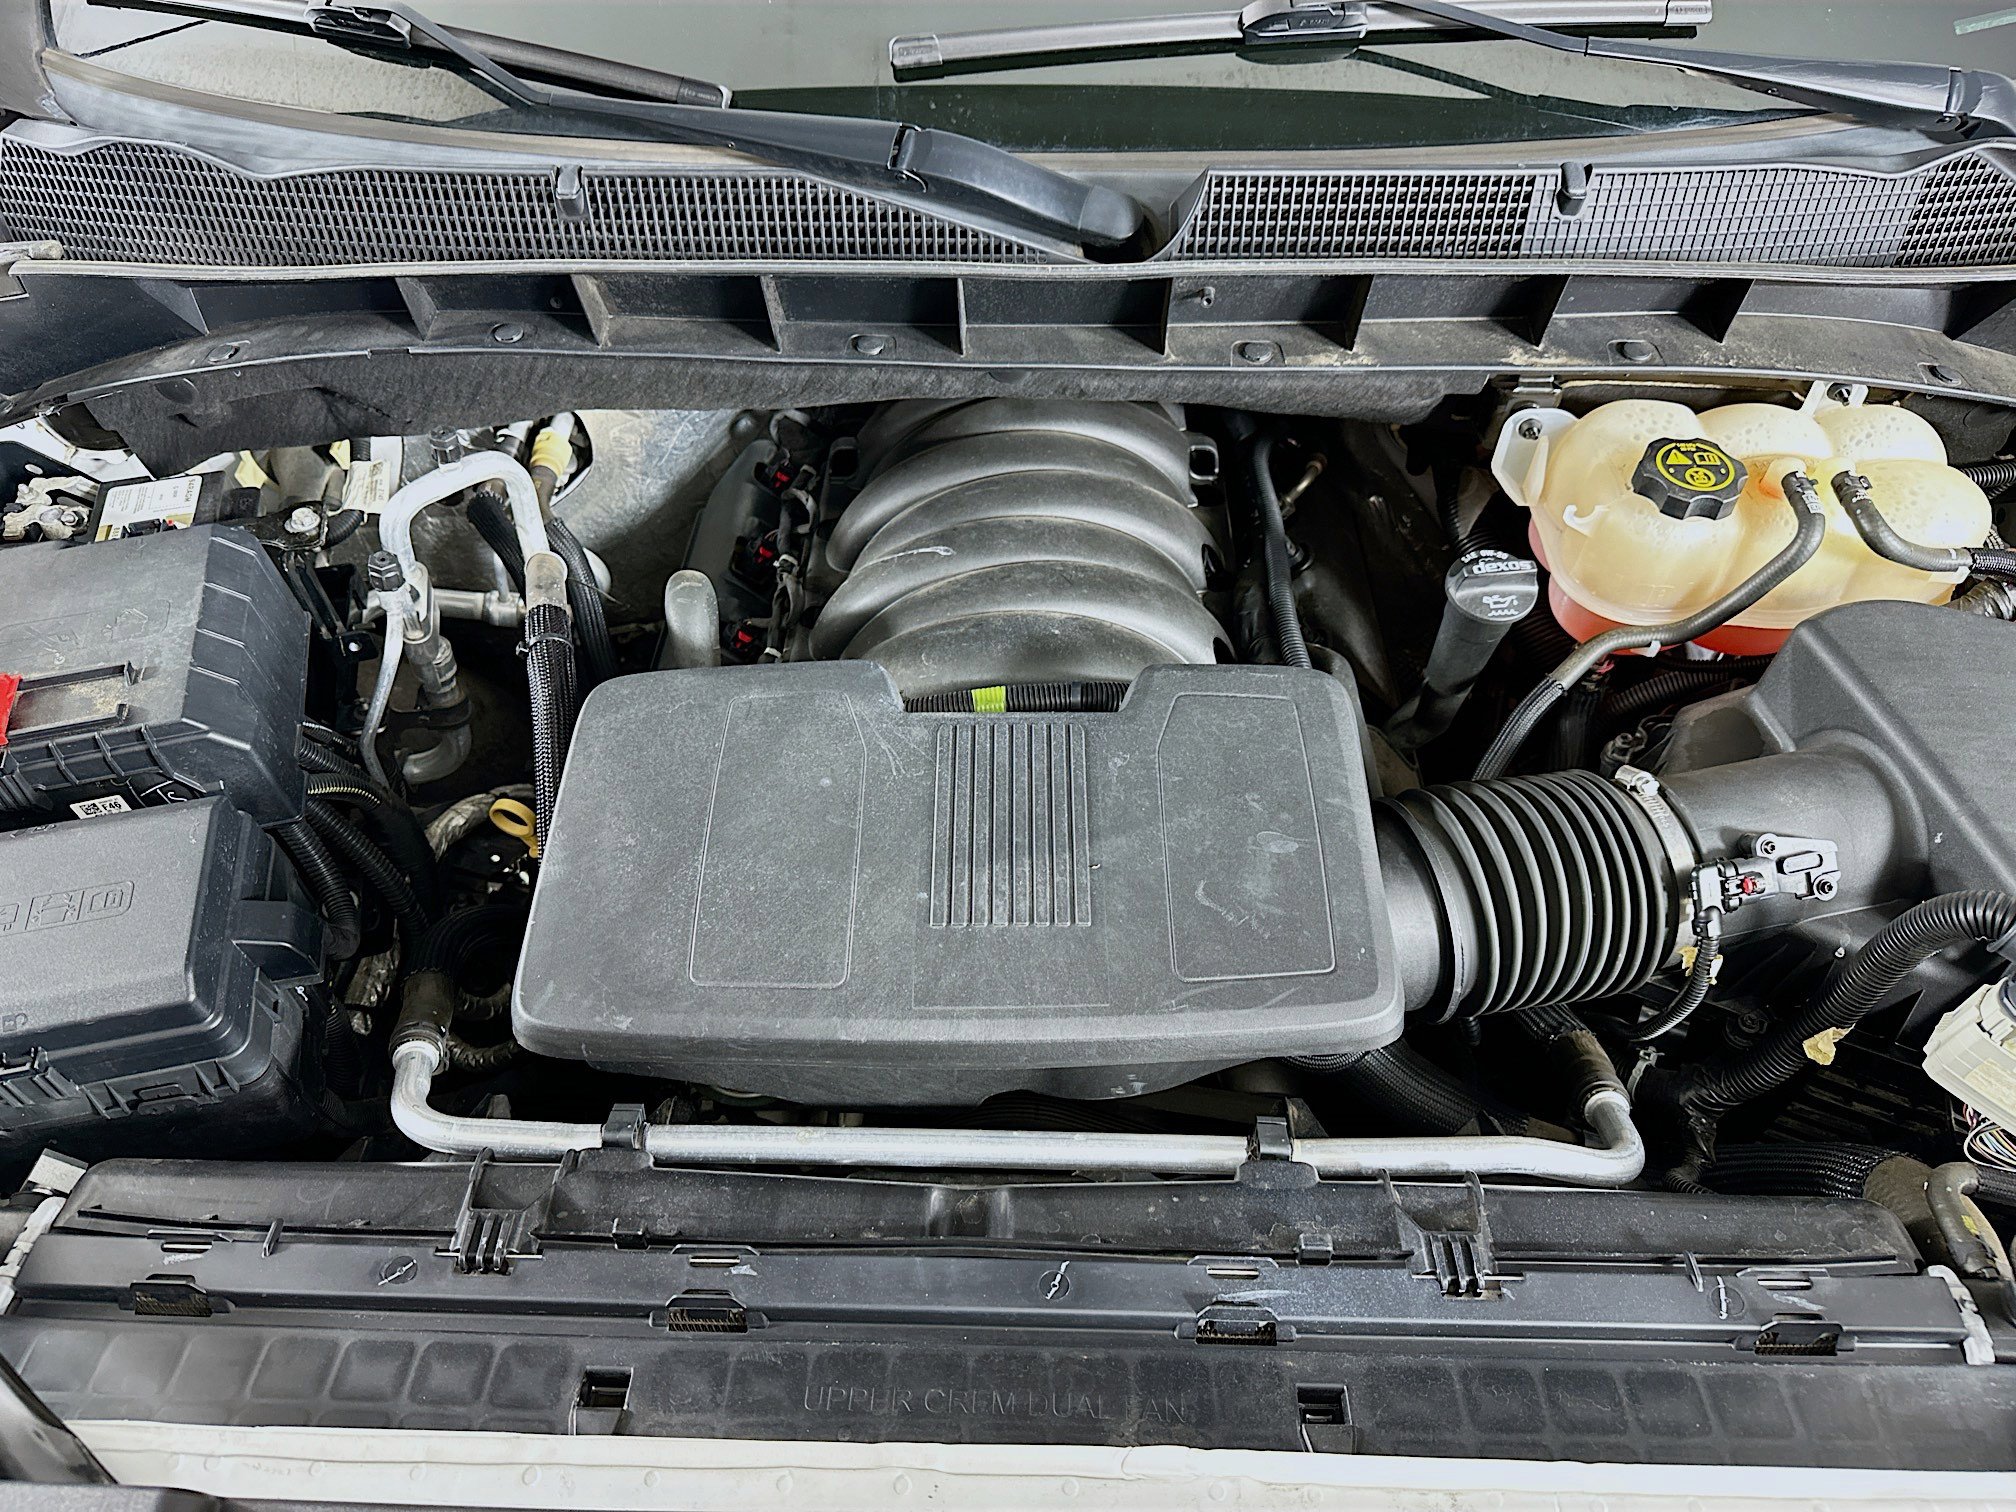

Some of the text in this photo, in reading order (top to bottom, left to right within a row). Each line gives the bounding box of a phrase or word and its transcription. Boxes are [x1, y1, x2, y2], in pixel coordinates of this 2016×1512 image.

[1461, 549, 1509, 564] SAE 0W-20
[1472, 560, 1533, 574] dexos
[102, 801, 122, 811] F46
[804, 1386, 912, 1412] UPPER
[1028, 1391, 1114, 1418] DUAL
